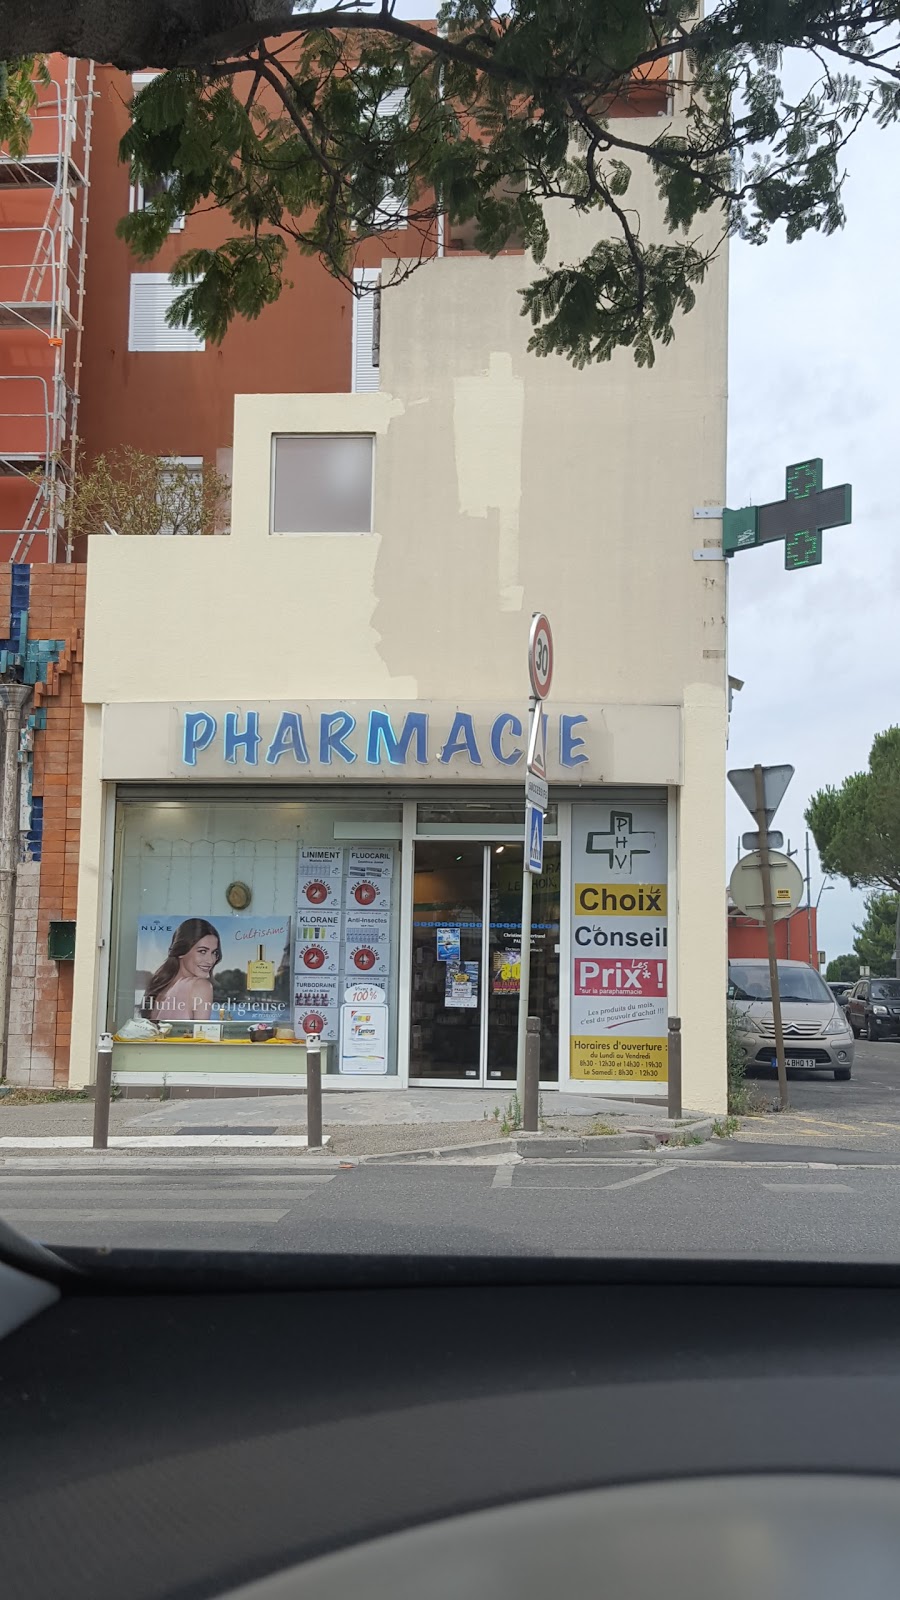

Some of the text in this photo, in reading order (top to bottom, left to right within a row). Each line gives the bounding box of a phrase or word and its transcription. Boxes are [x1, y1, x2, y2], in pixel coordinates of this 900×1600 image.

[536, 638, 549, 676] 30
[650, 886, 661, 895] Le
[580, 888, 662, 911] Choix
[593, 924, 602, 932] Le
[575, 926, 667, 947] Conseil
[631, 959, 649, 970] Les
[353, 991, 369, 1001] 100
[141, 996, 286, 1017] Huile Prodigieuse
[600, 1006, 626, 1016] produits
[597, 1015, 605, 1023] du
[606, 1013, 631, 1022] pouvoir
[632, 1008, 656, 1018] d'achat
[574, 1041, 611, 1050] Horaires
[613, 1041, 663, 1051] d'ouverture
[590, 1051, 598, 1059] du
[625, 1052, 651, 1060] Vendredi
[623, 1060, 640, 1068] 14h30
[640, 1069, 659, 1077] 12h30
